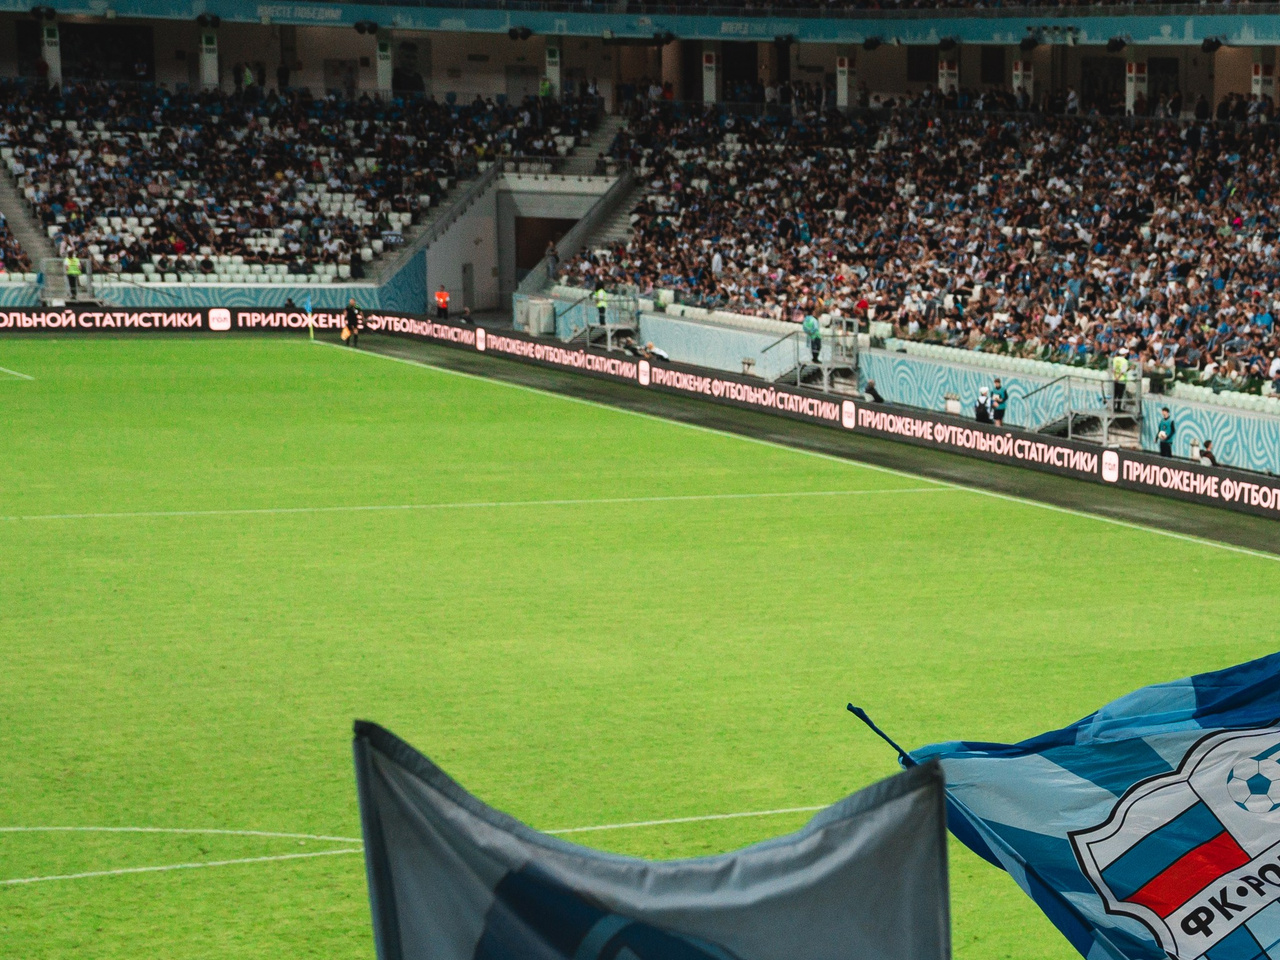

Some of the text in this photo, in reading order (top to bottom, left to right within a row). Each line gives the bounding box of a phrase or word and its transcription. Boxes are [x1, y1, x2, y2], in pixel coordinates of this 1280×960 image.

[78, 312, 202, 328] СТАТИСТИКИ
[366, 314, 432, 337] ФУТБОЛЬНОЙ
[432, 323, 475, 346] СТАТИСТИКИ
[486, 333, 637, 380] ПРИЛОЖЕНИЕ ФУТБОЛЬНОЙ СТАТИСТИКИ
[651, 367, 840, 422] ПРИЛОЖЕНИЕ ФУТБОЛЬНОЙ СТАТИСТИКИ
[858, 408, 1098, 474] ПРИЛОЖЕНИЕ ФУТБОЛЬНОЙ СТАТИСТИКИ
[1123, 460, 1219, 498] ПРИЛОЖЕНИЕ
